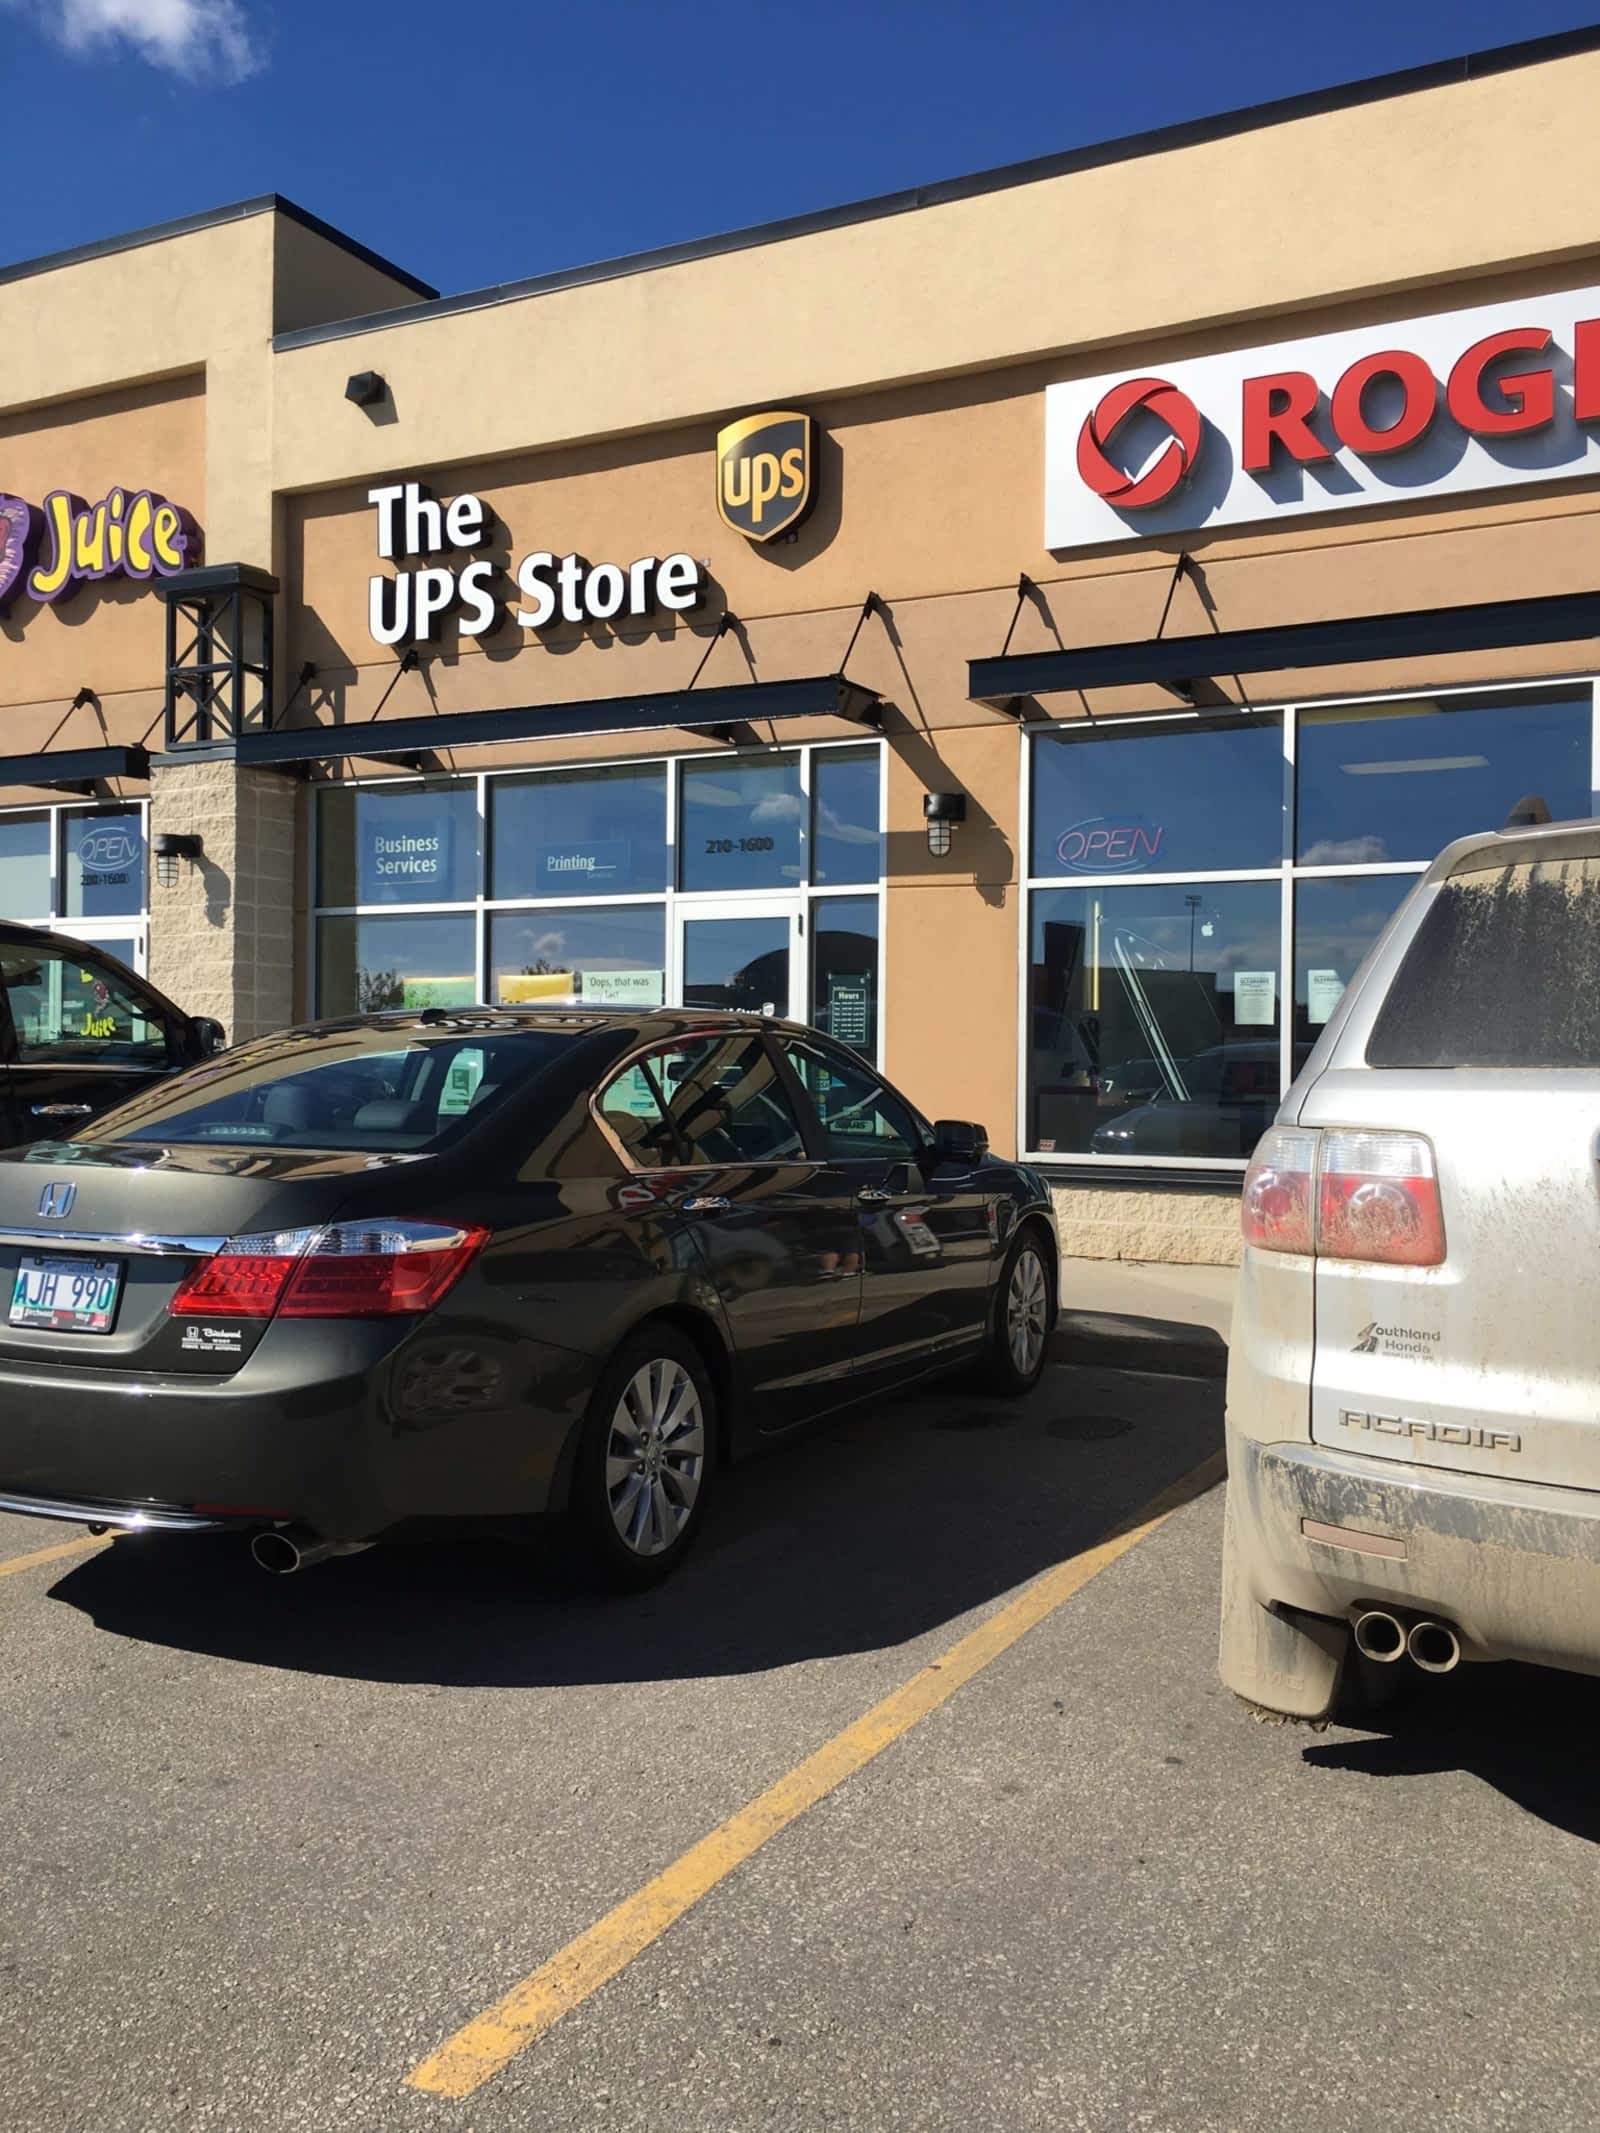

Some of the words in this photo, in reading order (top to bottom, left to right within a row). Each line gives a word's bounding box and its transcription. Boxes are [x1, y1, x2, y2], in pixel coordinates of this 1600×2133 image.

[724, 447, 805, 523] ups
[368, 482, 484, 558] The
[31, 490, 184, 595] Juice
[368, 560, 496, 645] UPS
[517, 551, 699, 628] Store
[79, 836, 137, 861] OPEN
[375, 834, 440, 854] Business
[1057, 826, 1163, 861] OPEN
[375, 856, 438, 875] Services
[546, 854, 596, 872] Printing
[14, 1271, 60, 1307] AJH
[71, 1276, 114, 1311] 990
[1384, 1339, 1431, 1354] Honda
[1338, 1408, 1522, 1453] ACADIA
